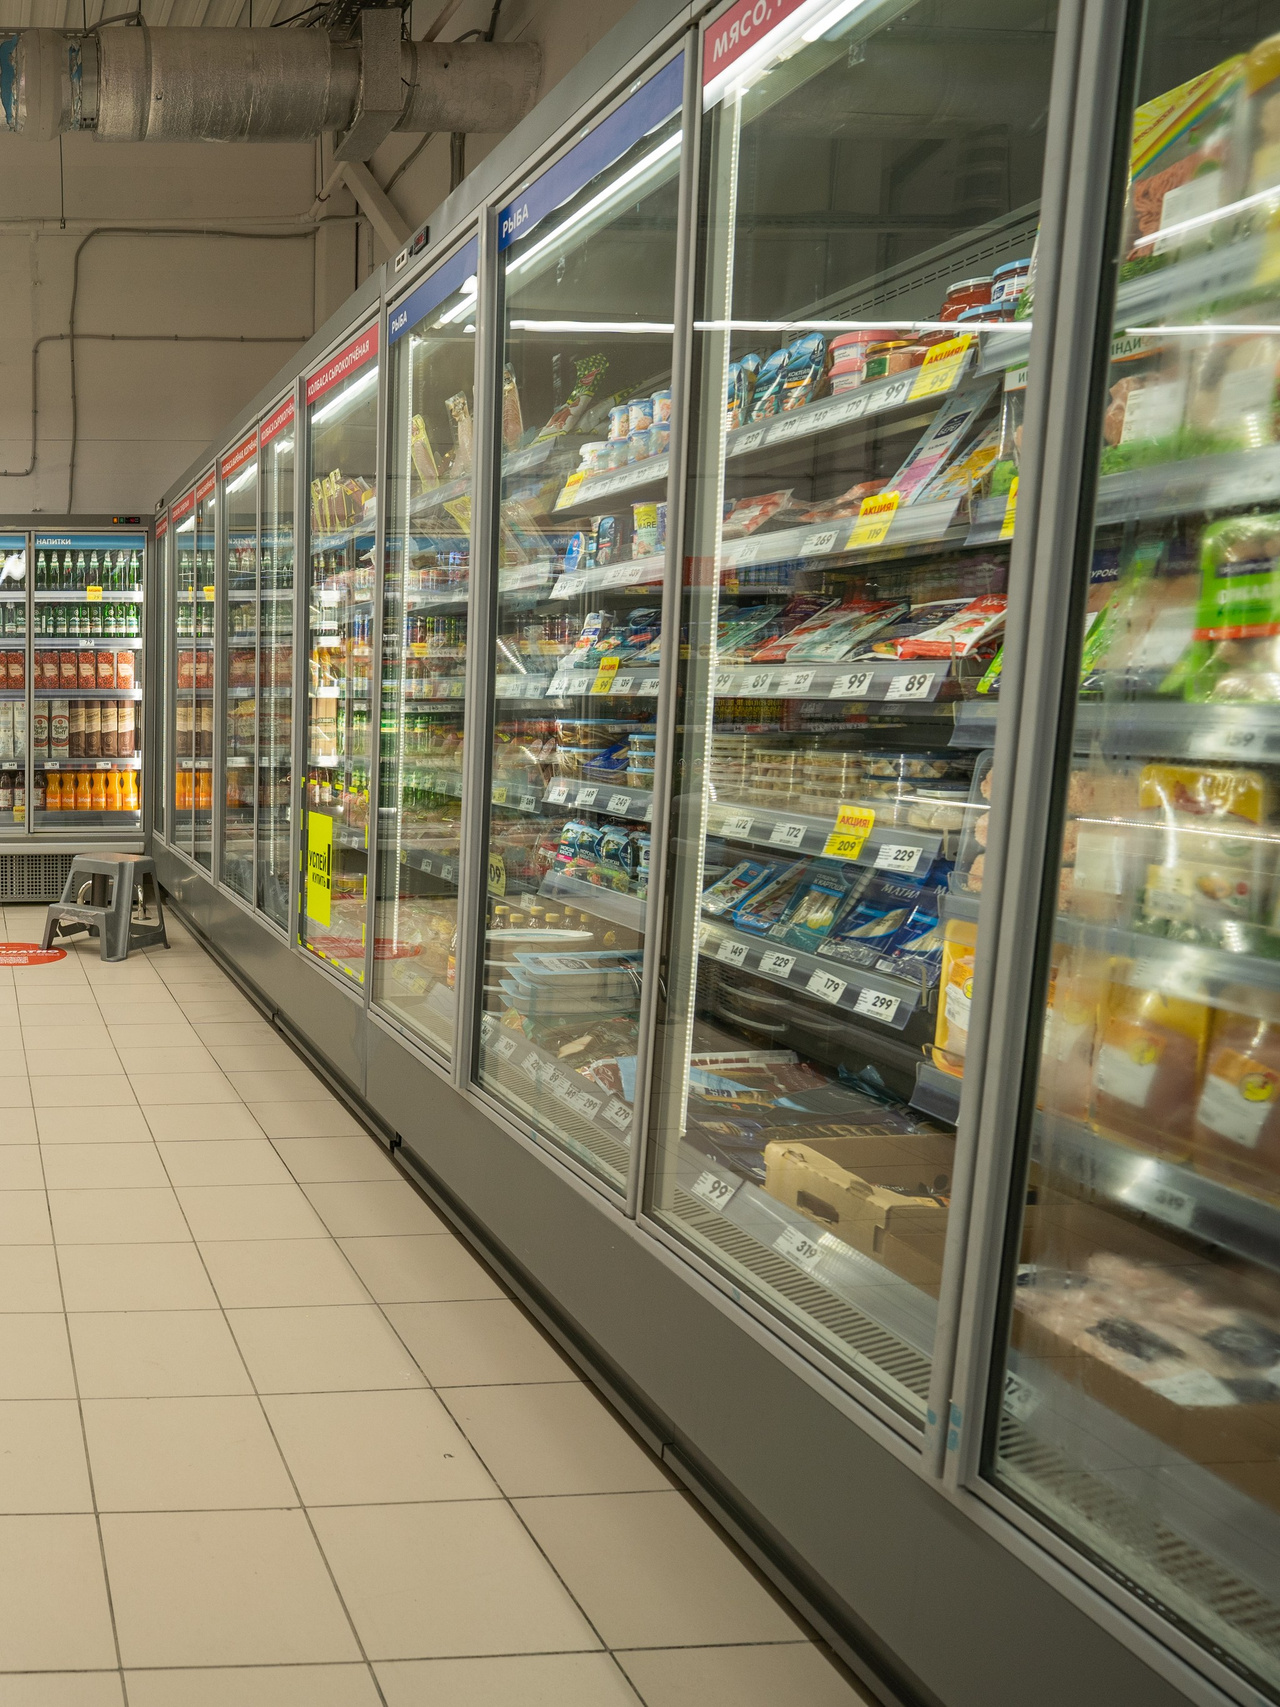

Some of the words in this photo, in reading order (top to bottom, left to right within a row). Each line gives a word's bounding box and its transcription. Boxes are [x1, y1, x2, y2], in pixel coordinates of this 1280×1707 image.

[713, 1, 772, 63] МЯСО,
[502, 203, 530, 239] РЫБА
[391, 310, 408, 335] РЫБА
[926, 345, 964, 366] АКЦИЯ!
[308, 374, 330, 398] КОЛБАСА
[329, 339, 370, 384] СЫРОКОПЧЁНАЯ
[930, 374, 949, 391] 99
[886, 383, 906, 400] 99
[846, 400, 862, 414] 179
[744, 434, 759, 445] 239
[862, 501, 895, 517] АКЦИЯ!
[637, 520, 657, 530] MARE
[36, 537, 71, 546] НАПИТКИ
[816, 534, 832, 547] 269
[869, 528, 883, 540] 119
[599, 678, 609, 689] 99
[716, 673, 730, 688] 99
[752, 673, 769, 689] 89
[794, 672, 810, 686] 129
[847, 673, 868, 690] 99
[904, 673, 928, 692] 89
[584, 788, 595, 798] 149
[734, 817, 748, 829] 172
[839, 814, 871, 830] АКЦИЯ!
[786, 825, 801, 839] 172
[837, 840, 857, 852] 209
[309, 850, 327, 872] УСПЕЙ
[892, 849, 915, 862] 229
[312, 872, 326, 888] КУПИТЬ
[729, 945, 744, 957] 149
[772, 955, 790, 968] 229
[823, 977, 841, 993] 179
[871, 995, 893, 1010] 299
[549, 1072, 560, 1083] 89
[583, 1096, 598, 1111] 299
[614, 1106, 630, 1121] 279
[711, 1179, 729, 1198] 99
[796, 1240, 818, 1260] 319
